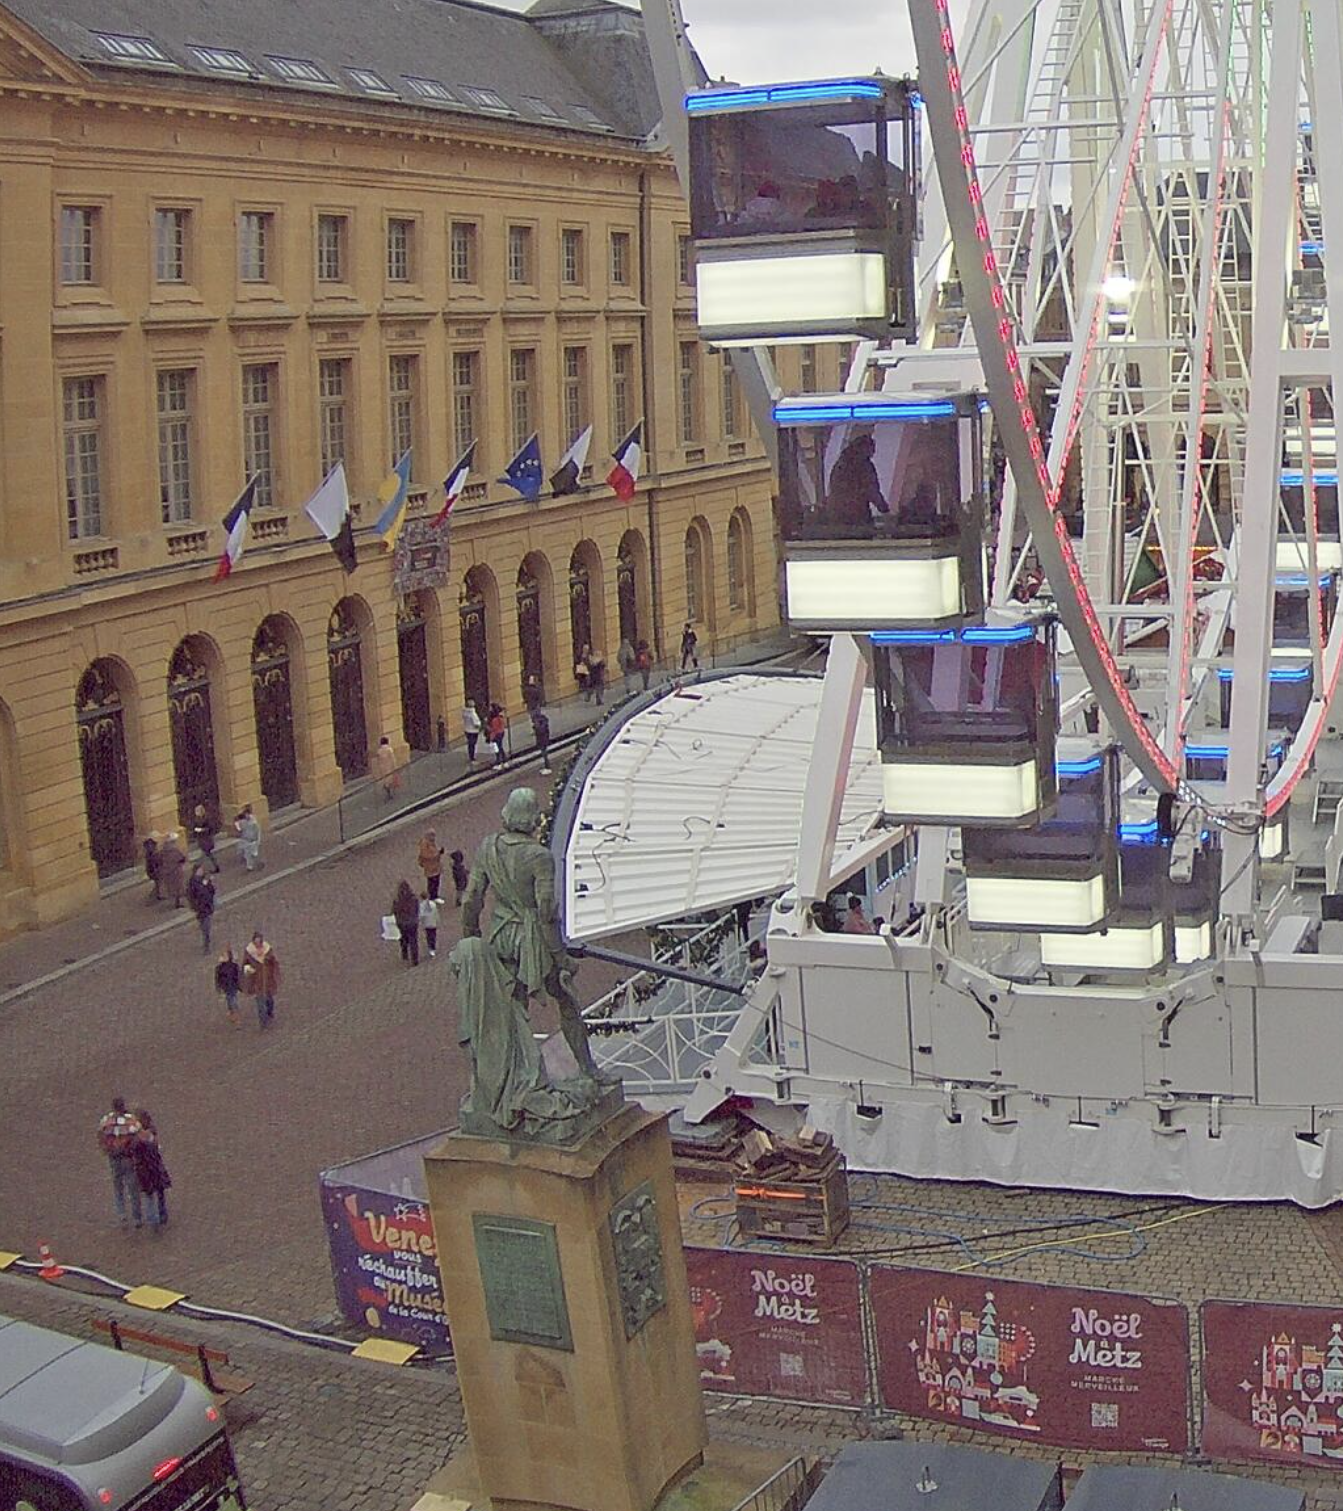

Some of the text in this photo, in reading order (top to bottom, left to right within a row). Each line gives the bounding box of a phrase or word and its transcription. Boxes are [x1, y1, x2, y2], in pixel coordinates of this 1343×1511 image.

[364, 1211, 440, 1261] Vene
[358, 1254, 438, 1288] réchauffer
[393, 1250, 422, 1263] vous
[385, 1281, 445, 1312] Musé
[751, 1270, 817, 1297] Noël
[754, 1295, 820, 1324] Metz
[1070, 1307, 1143, 1338] Noël
[1069, 1338, 1142, 1368] Metz
